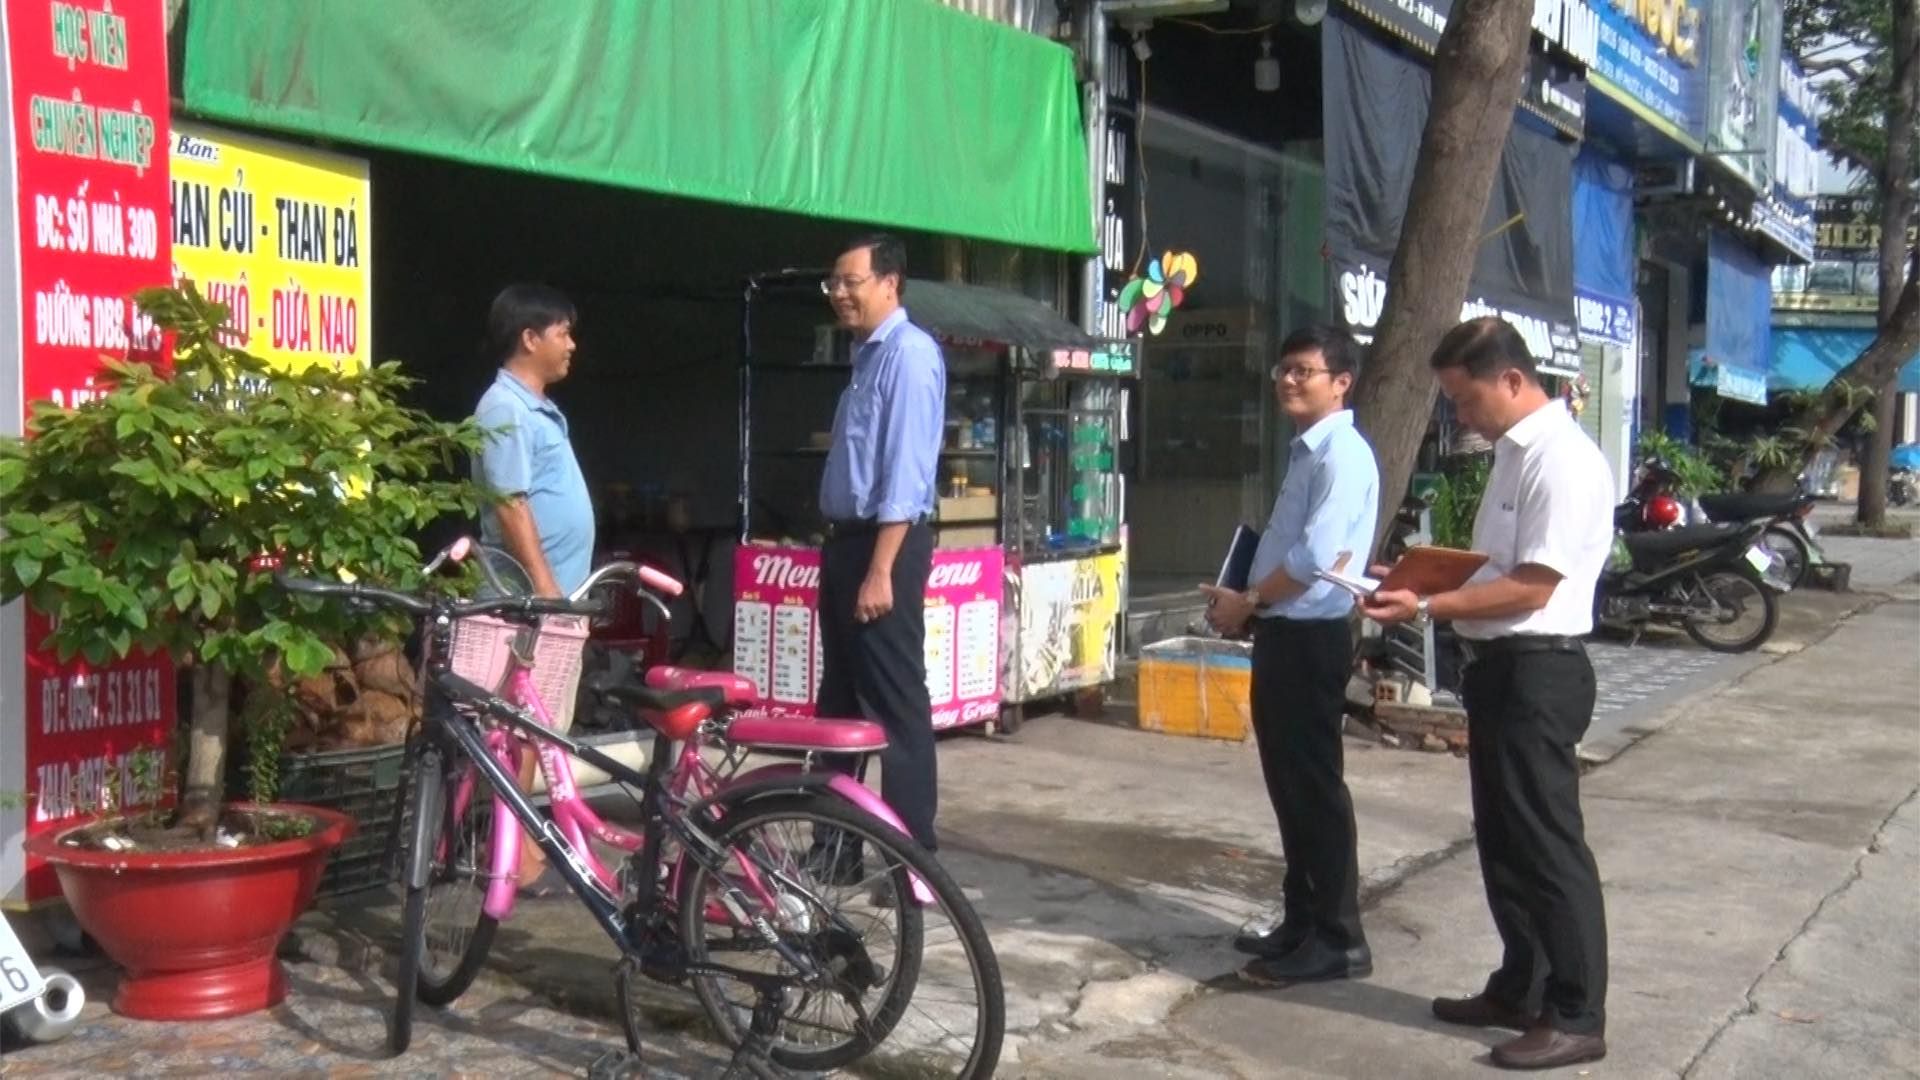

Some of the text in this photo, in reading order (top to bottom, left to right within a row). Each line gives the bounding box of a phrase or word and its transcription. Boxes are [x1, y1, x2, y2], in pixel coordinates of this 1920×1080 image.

[51, 1, 88, 71] HỌC
[30, 87, 156, 178] CHUYÊN NGHIỆP
[67, 179, 89, 253] SỐ
[92, 190, 125, 257] NHÀ
[219, 168, 253, 255] CỦI
[275, 197, 327, 264] THAN
[333, 197, 359, 268] ĐÁ
[36, 278, 92, 348] ĐƯỜNG
[273, 277, 312, 352] DỪA
